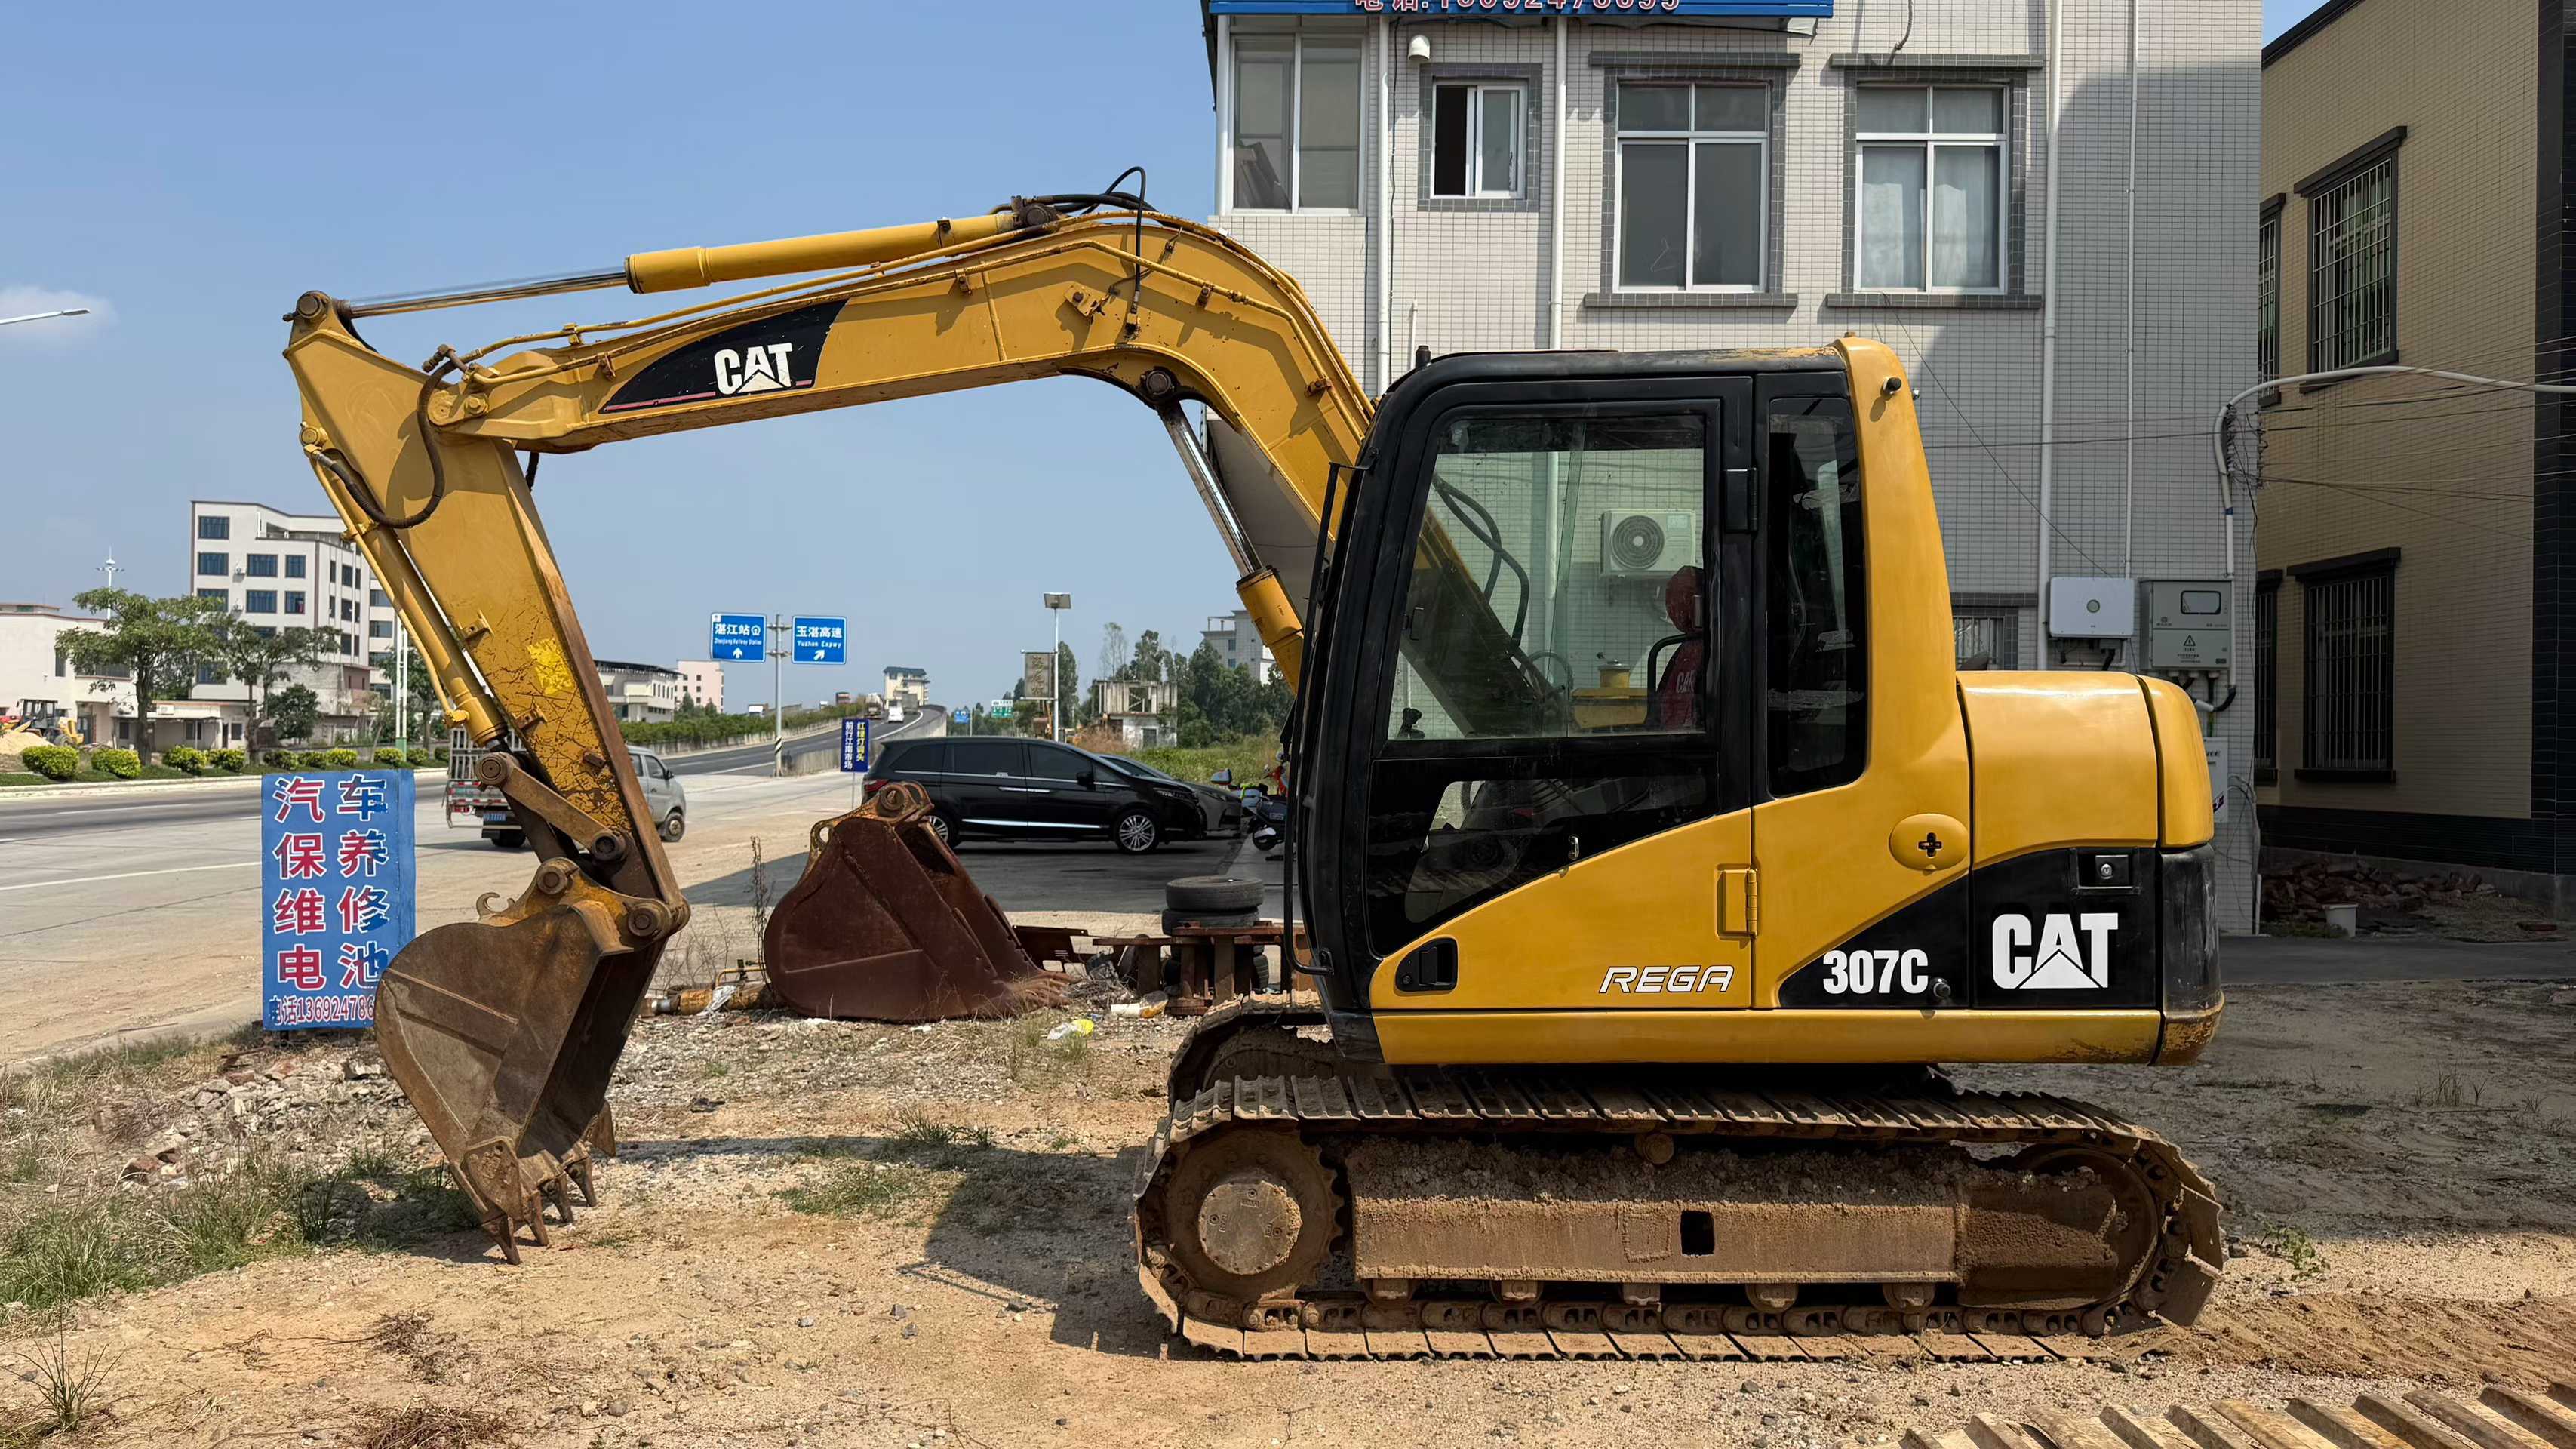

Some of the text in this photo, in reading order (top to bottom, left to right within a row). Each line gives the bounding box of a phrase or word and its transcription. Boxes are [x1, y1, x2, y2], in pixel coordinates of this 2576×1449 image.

[714, 342, 793, 395] CAT
[715, 623, 750, 635] 湛江站
[795, 626, 843, 638] 玉湛高速
[272, 774, 389, 823] 汽车
[272, 829, 389, 880] 保养
[273, 885, 390, 936] 维修
[278, 940, 389, 992] 电池
[1822, 948, 1929, 995] 307C
[1992, 913, 2119, 990] CAT
[1598, 965, 1735, 994] REGA
